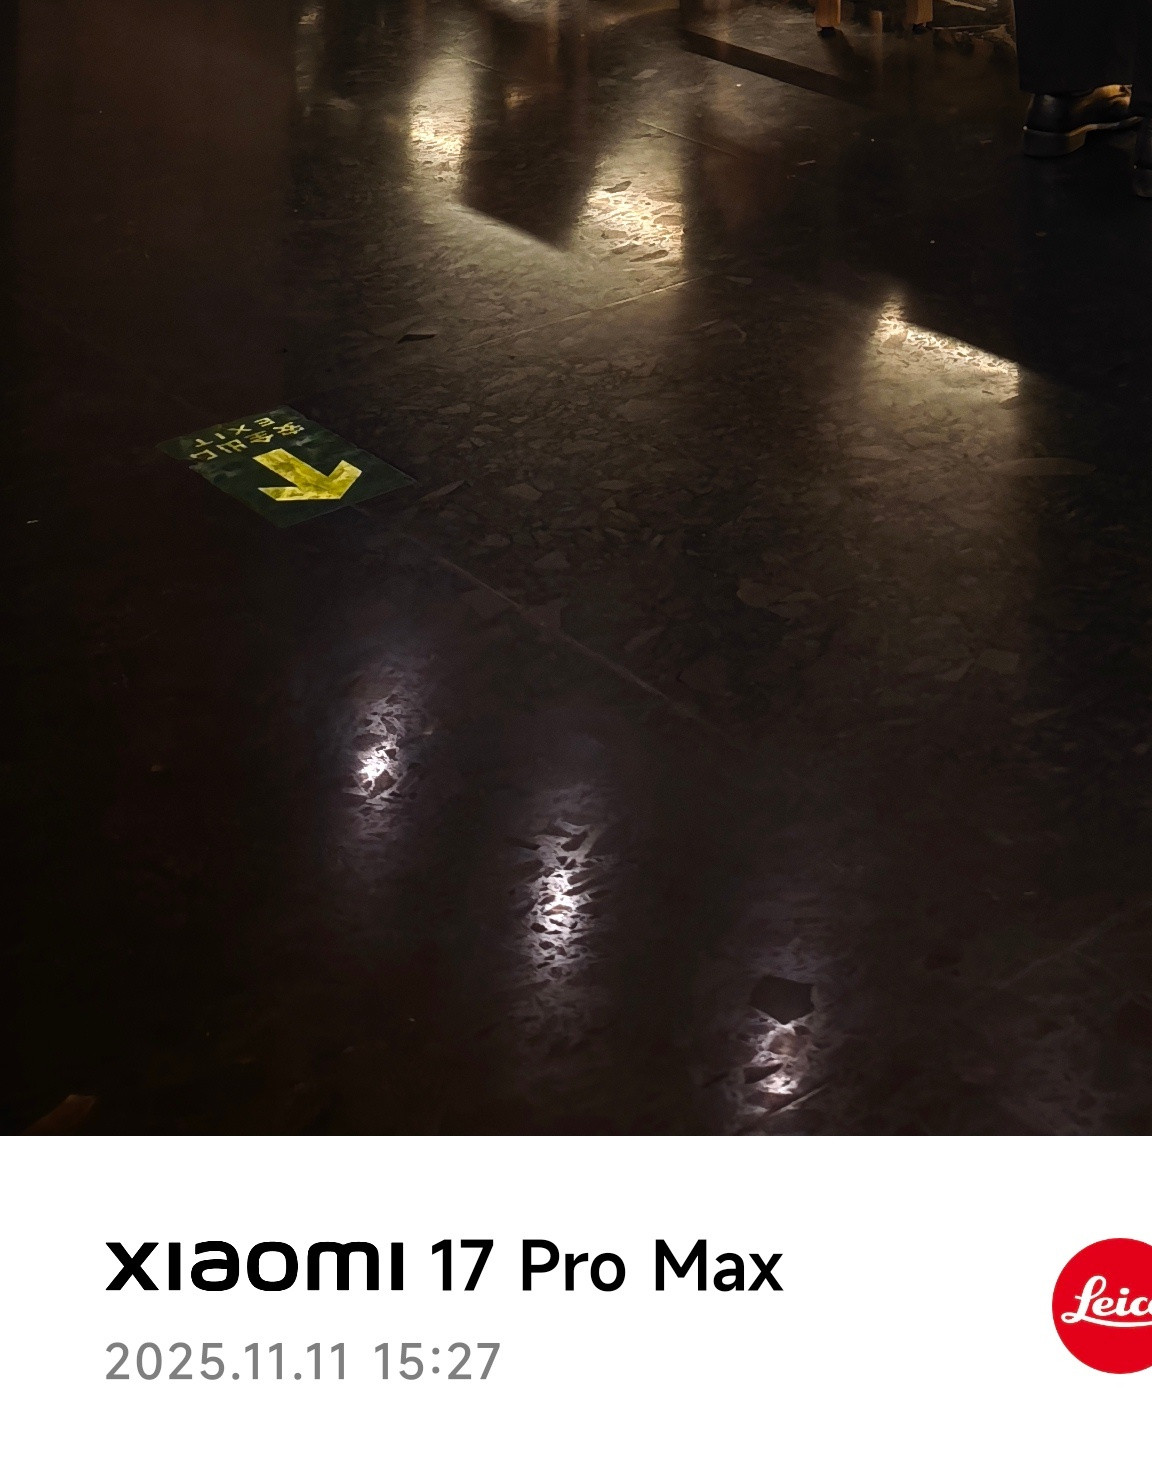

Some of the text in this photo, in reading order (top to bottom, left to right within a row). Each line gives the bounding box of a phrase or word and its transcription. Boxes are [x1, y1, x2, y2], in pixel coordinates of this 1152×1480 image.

[189, 421, 305, 462] 安全出口
[195, 416, 275, 448] EXIT
